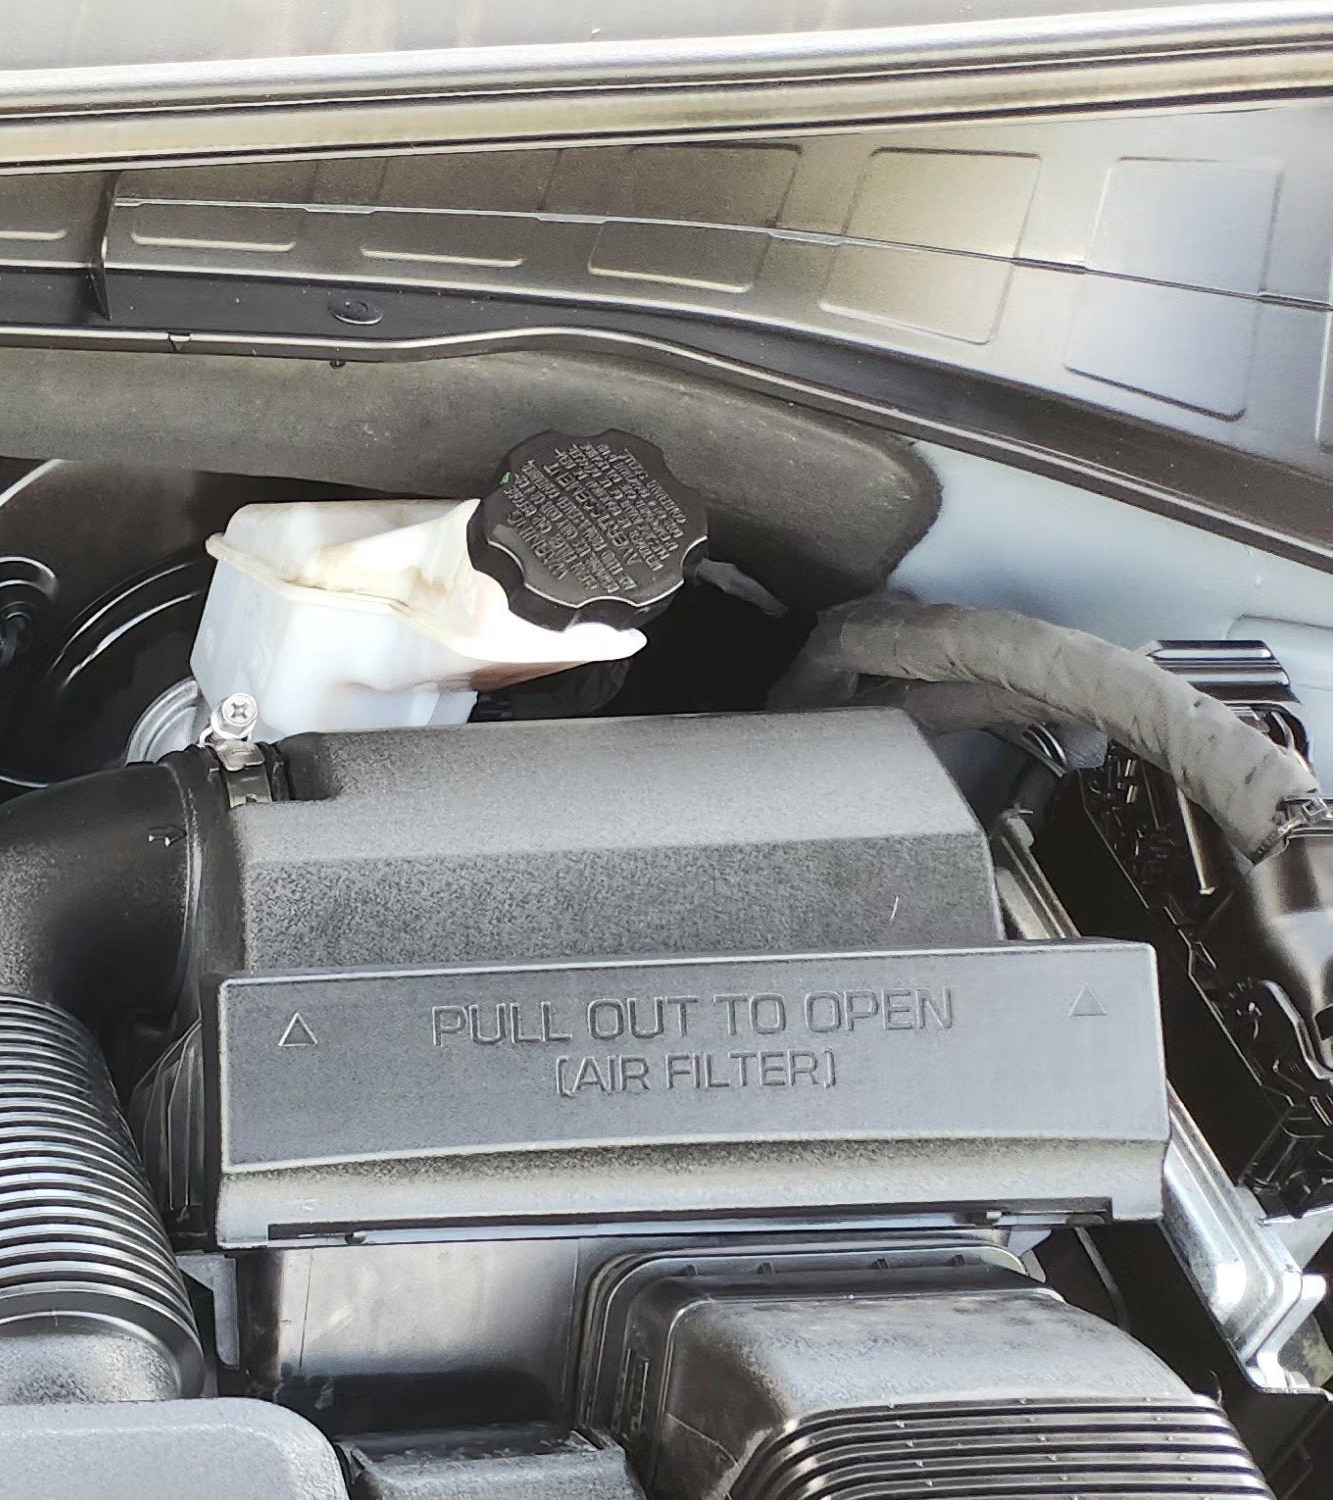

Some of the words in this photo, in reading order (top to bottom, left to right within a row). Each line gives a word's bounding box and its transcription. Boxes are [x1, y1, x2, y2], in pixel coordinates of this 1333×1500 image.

[506, 511, 568, 580] WARNING
[430, 999, 574, 1048] PULL
[586, 993, 700, 1041] OUT
[712, 991, 789, 1038] TO
[803, 986, 954, 1033] OPEN
